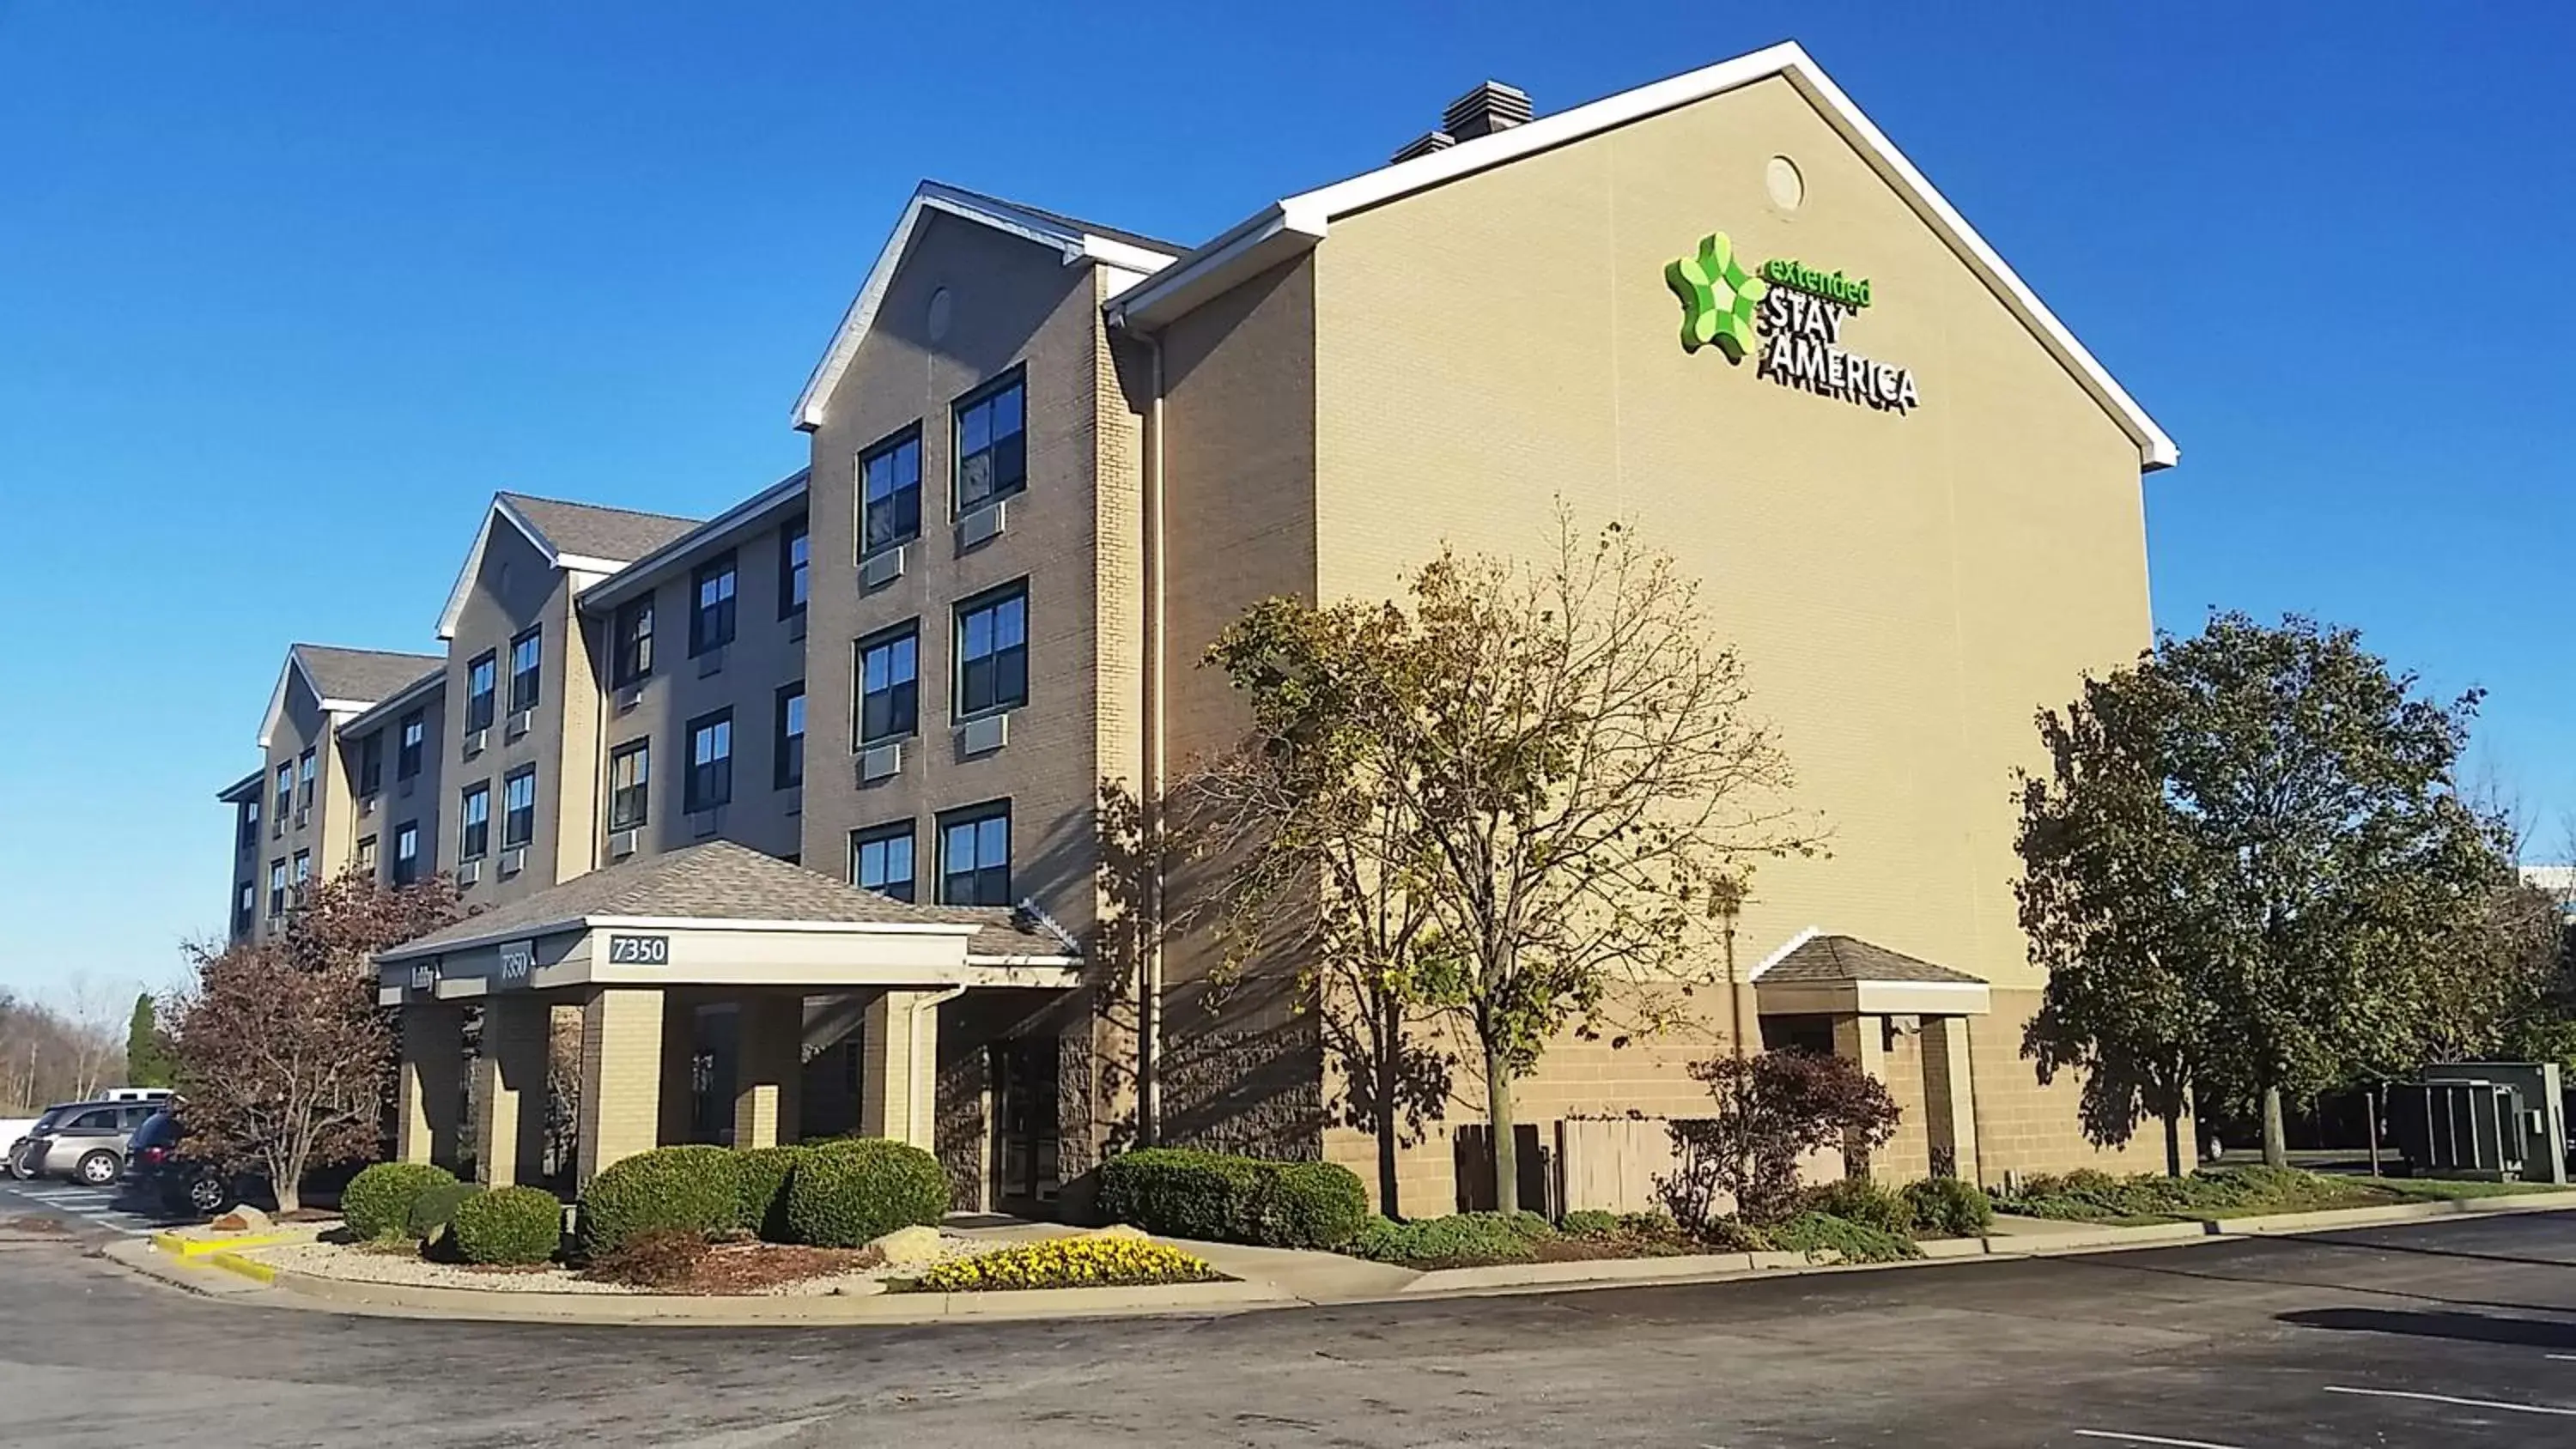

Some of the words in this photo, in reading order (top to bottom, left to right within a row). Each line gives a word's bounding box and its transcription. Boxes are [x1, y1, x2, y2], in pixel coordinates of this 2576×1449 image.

[1767, 258, 1871, 307] extended
[1770, 287, 1846, 345] STAY
[1770, 333, 1920, 409] AMERICA
[501, 951, 527, 979] 7350
[614, 938, 665, 961] 7350
